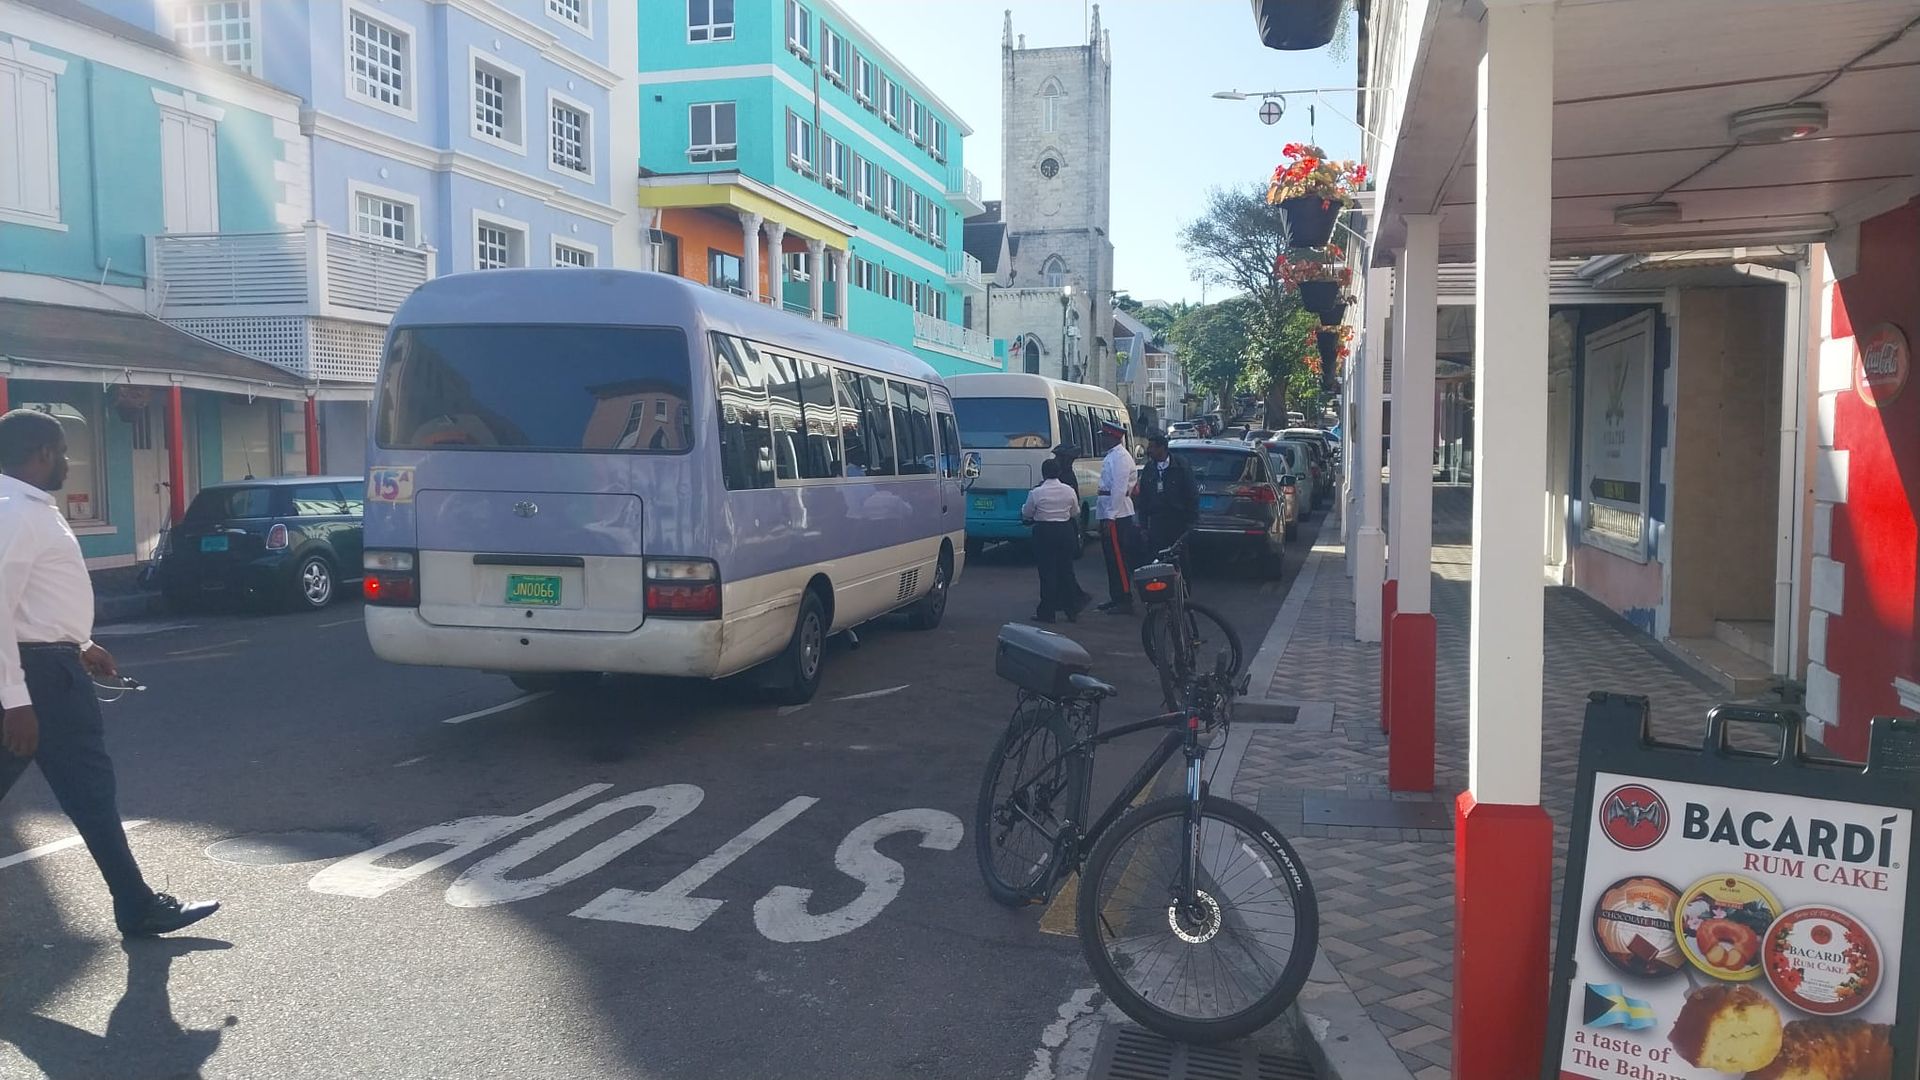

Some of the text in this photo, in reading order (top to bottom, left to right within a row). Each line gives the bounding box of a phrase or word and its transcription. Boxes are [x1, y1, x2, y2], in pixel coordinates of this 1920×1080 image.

[307, 783, 965, 943] STOP
[1277, 848, 1303, 891] PATROL
[1742, 852, 1889, 892] RUM CAKE
[1572, 1047, 1610, 1071] The
[1574, 1030, 1672, 1063] a taste of
